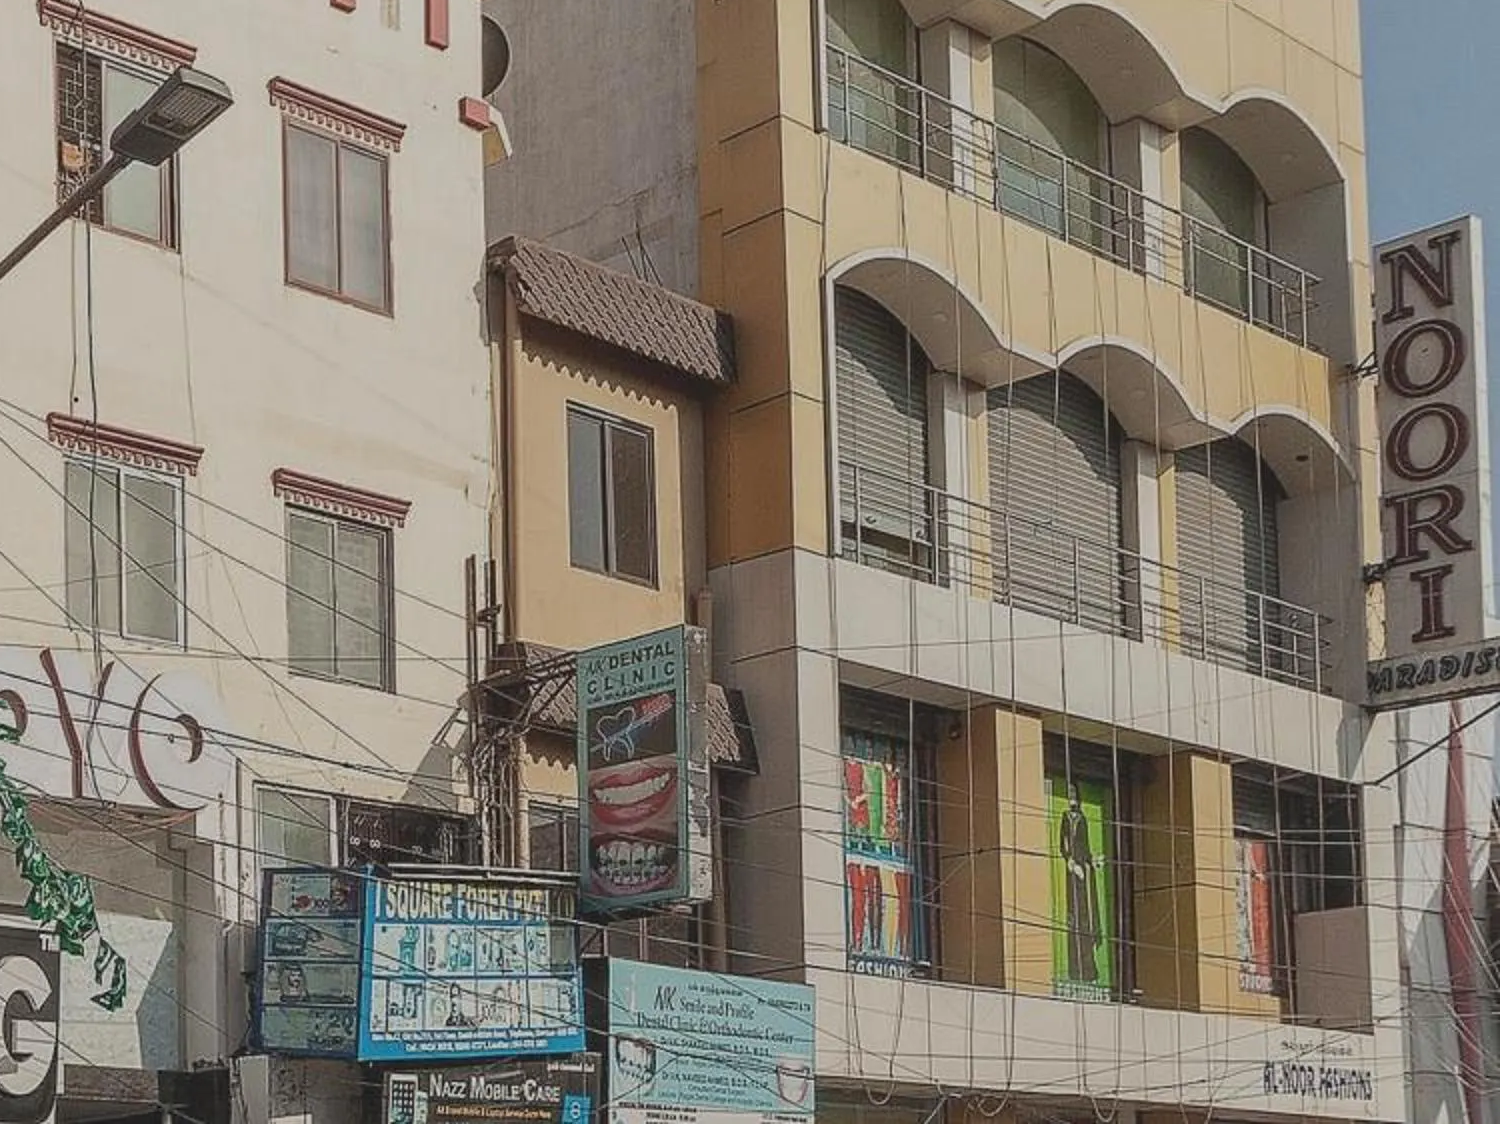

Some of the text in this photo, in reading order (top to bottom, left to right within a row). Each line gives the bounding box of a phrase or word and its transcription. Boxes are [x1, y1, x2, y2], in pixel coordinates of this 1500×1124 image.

[1379, 230, 1475, 644] NOORI
[609, 641, 676, 670] DENTAL
[586, 662, 676, 695] CLINIC
[386, 881, 453, 922] SQUARE
[457, 884, 510, 921] FOREX
[429, 1073, 561, 1103] NAZZ MOBILE CARE
